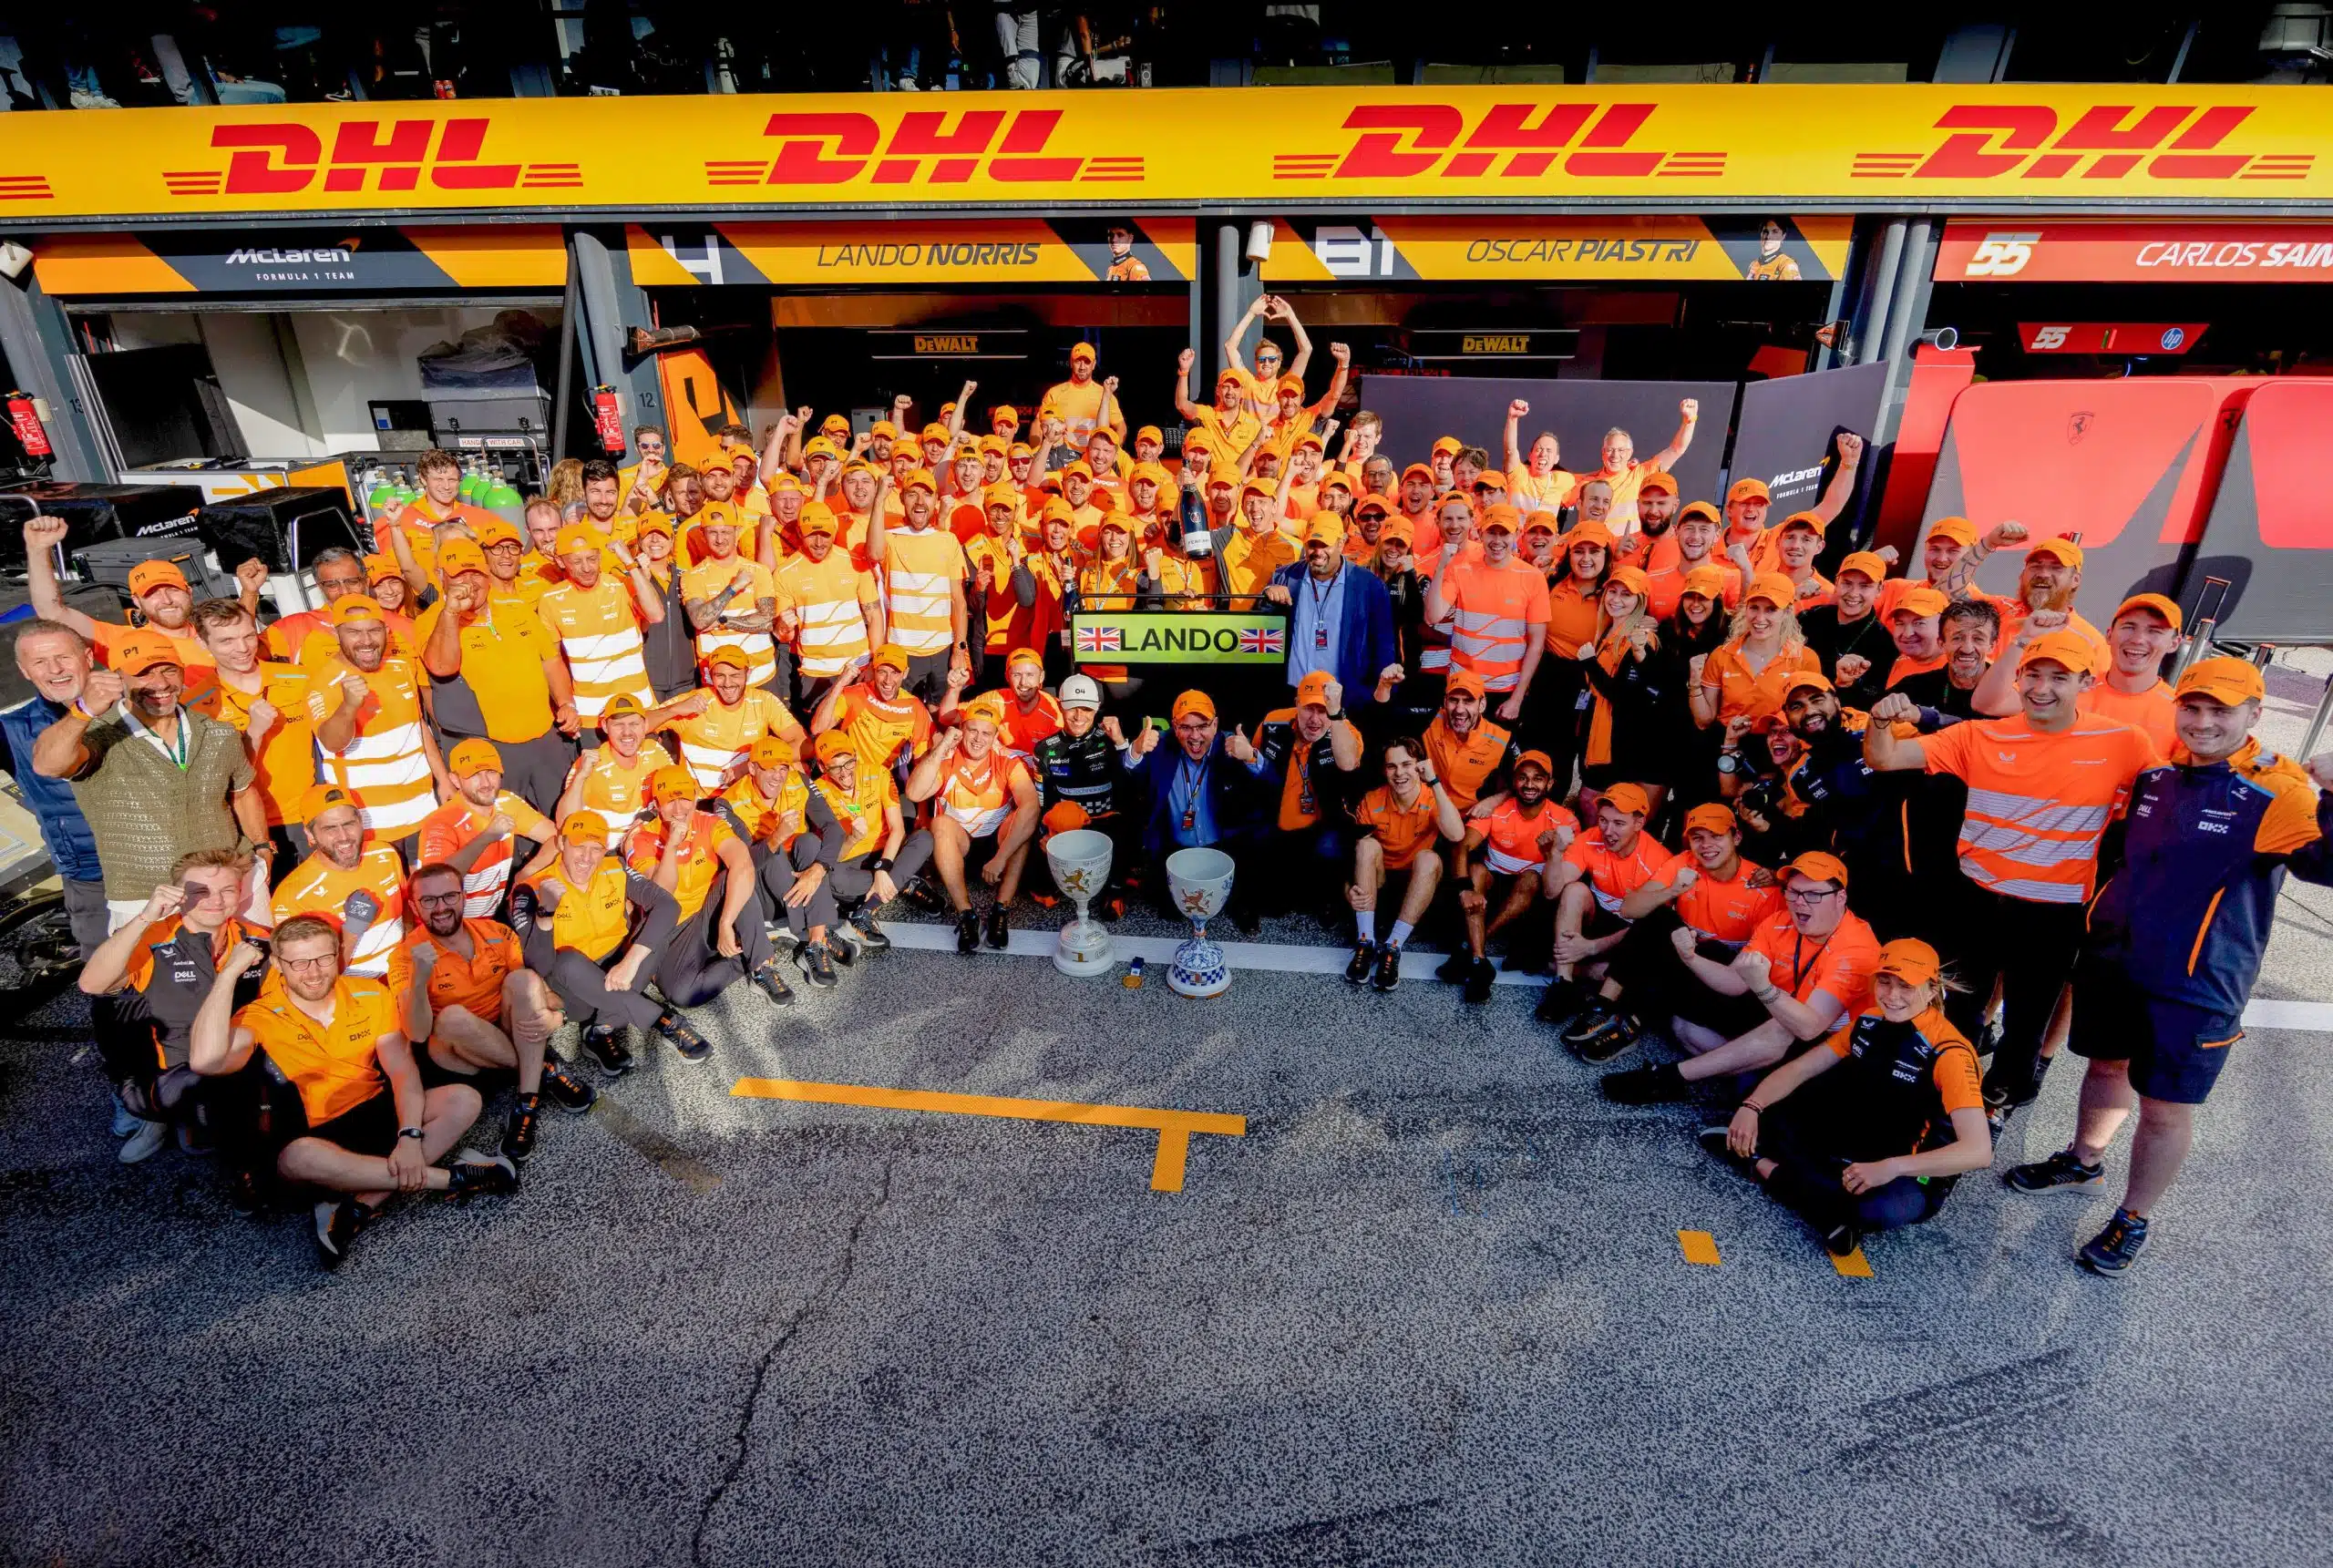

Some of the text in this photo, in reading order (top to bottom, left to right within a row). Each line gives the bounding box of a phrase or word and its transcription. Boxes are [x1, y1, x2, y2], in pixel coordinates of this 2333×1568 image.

[763, 109, 1084, 184] DHL
[1334, 103, 1667, 178] DHL
[1912, 105, 2258, 179] DHL
[211, 118, 522, 194] DHL
[225, 248, 349, 264] McLaren
[817, 242, 1041, 267] LANDO NORRIS
[1467, 239, 1701, 261] OSCAR PIASTRI
[1965, 232, 2043, 276] 55
[2136, 242, 2266, 266] CARLOS
[256, 272, 355, 282] FORMULA 1 TEAM
[2031, 326, 2071, 349] 55
[639, 392, 654, 407] 12
[1768, 466, 1822, 488] McLaren
[136, 515, 196, 538] McLaren
[446, 553, 457, 561] P1
[134, 572, 146, 583] P1
[1119, 628, 1238, 652] LANDO
[123, 646, 139, 658] P1
[2183, 672, 2197, 682] P1
[868, 694, 913, 713] ZANDVOORT
[459, 756, 470, 764] P1
[2137, 804, 2153, 813] DELL
[2197, 821, 2230, 834] OKX
[1892, 1069, 1917, 1082] OKX
